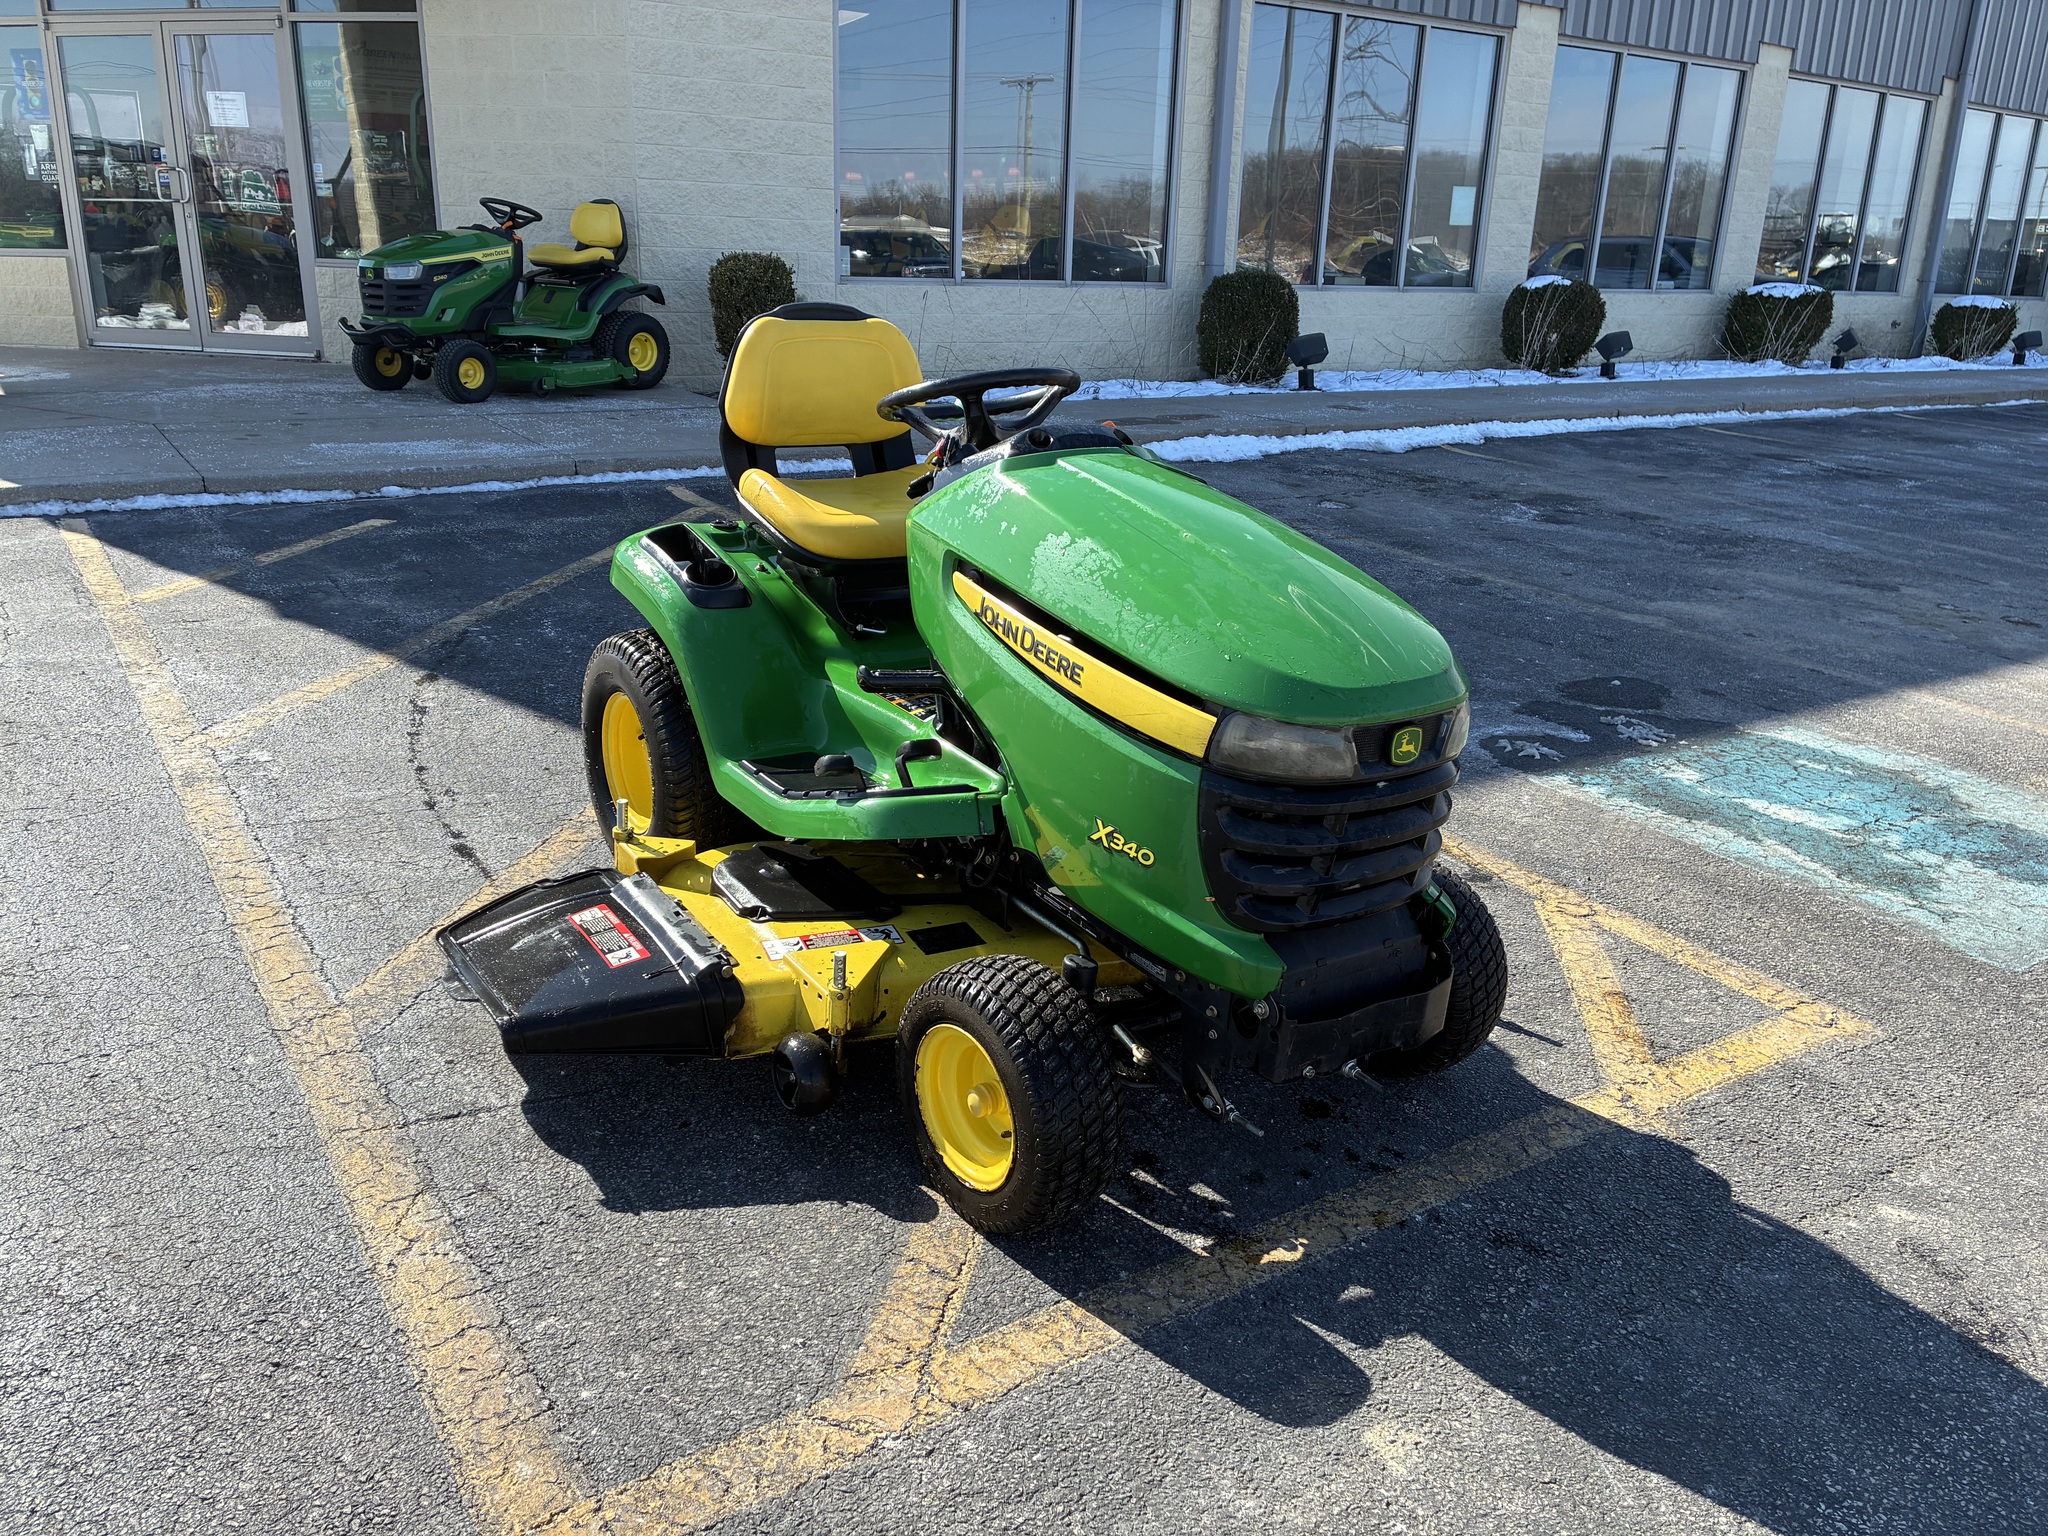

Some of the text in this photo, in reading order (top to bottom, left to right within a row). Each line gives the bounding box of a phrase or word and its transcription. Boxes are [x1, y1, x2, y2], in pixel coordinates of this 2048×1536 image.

[481, 249, 510, 259] JOHN DEERE
[974, 596, 1084, 688] JOHN DEERE
[1088, 817, 1155, 867] X340
[816, 930, 851, 938] DANGER
